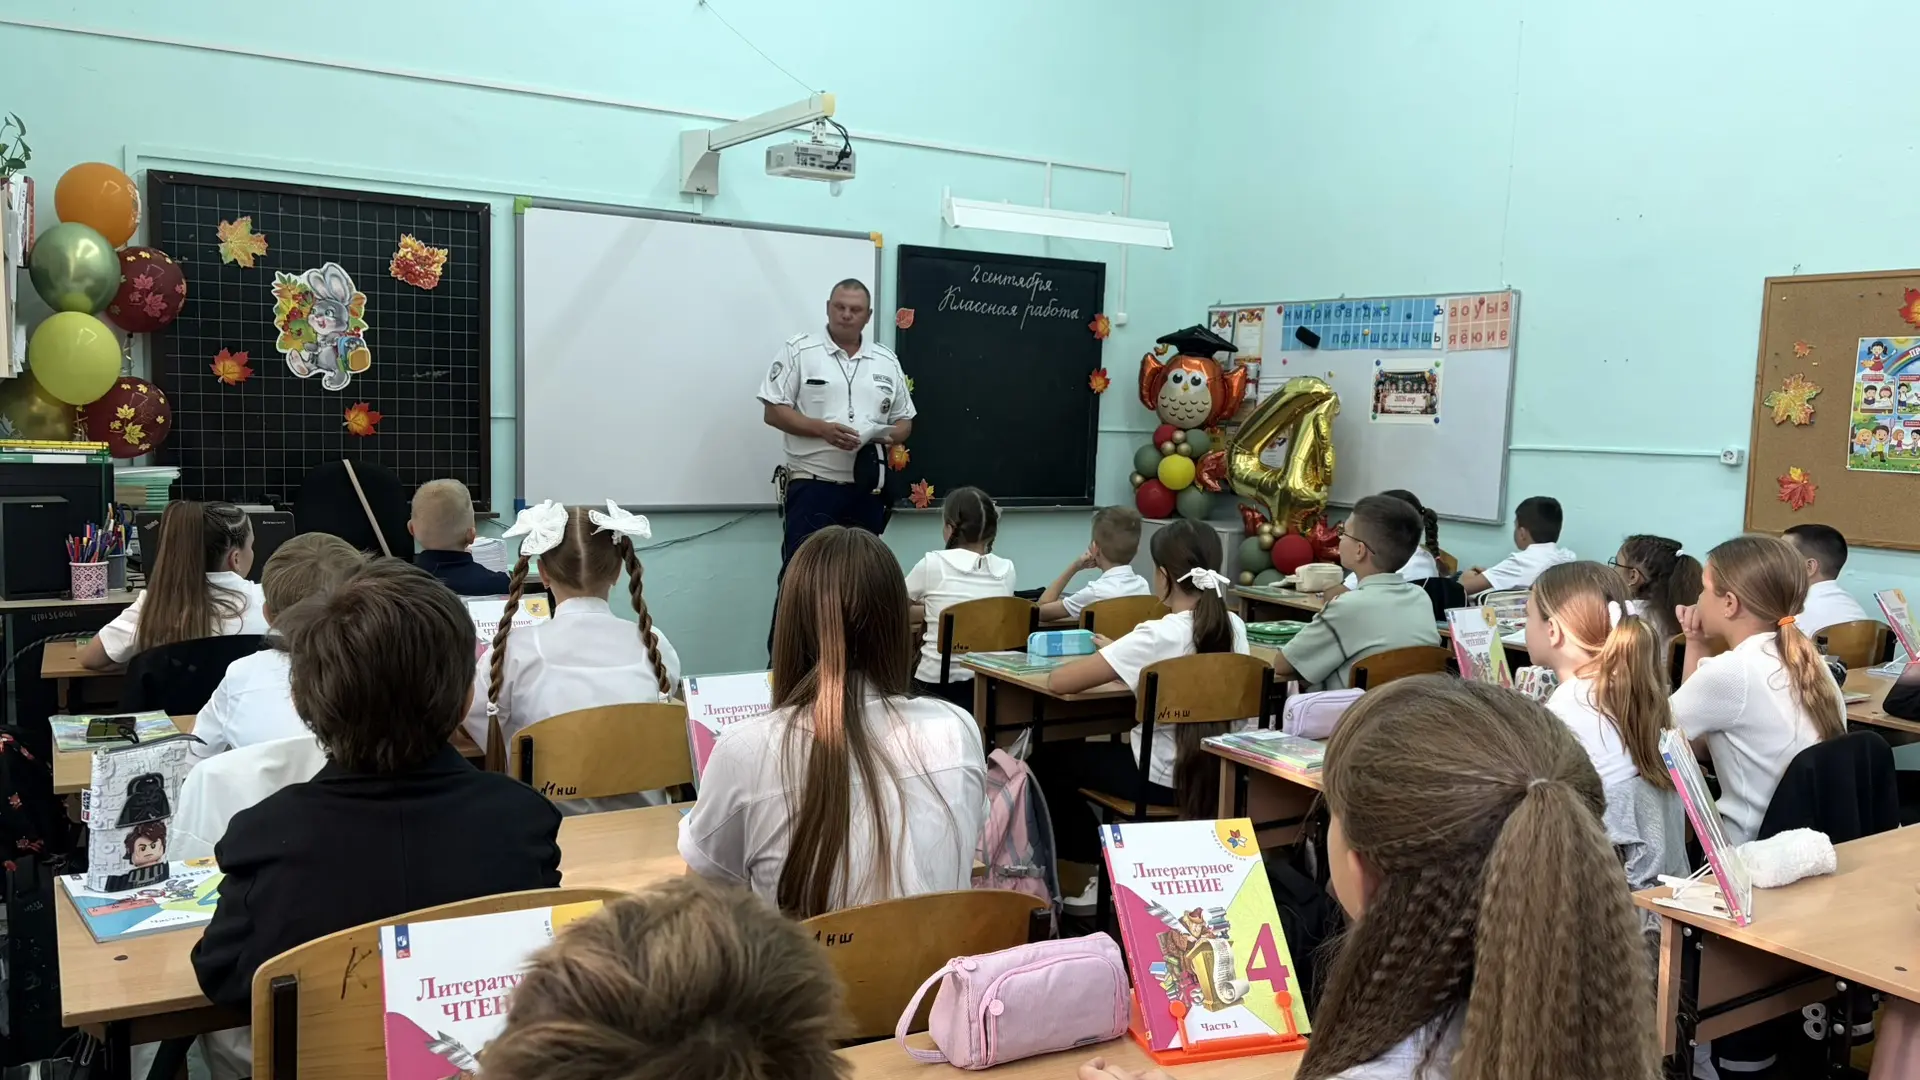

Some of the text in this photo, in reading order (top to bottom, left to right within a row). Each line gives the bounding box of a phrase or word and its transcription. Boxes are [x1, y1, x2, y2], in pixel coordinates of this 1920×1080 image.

[971, 264, 981, 283] 2
[938, 285, 1018, 316] Классная
[703, 702, 773, 716] Литературно
[1132, 862, 1235, 879] Литературное
[1150, 878, 1224, 896] ЧТЕНИЕ
[1245, 922, 1291, 993] 4
[1200, 1020, 1232, 1033] Часть
